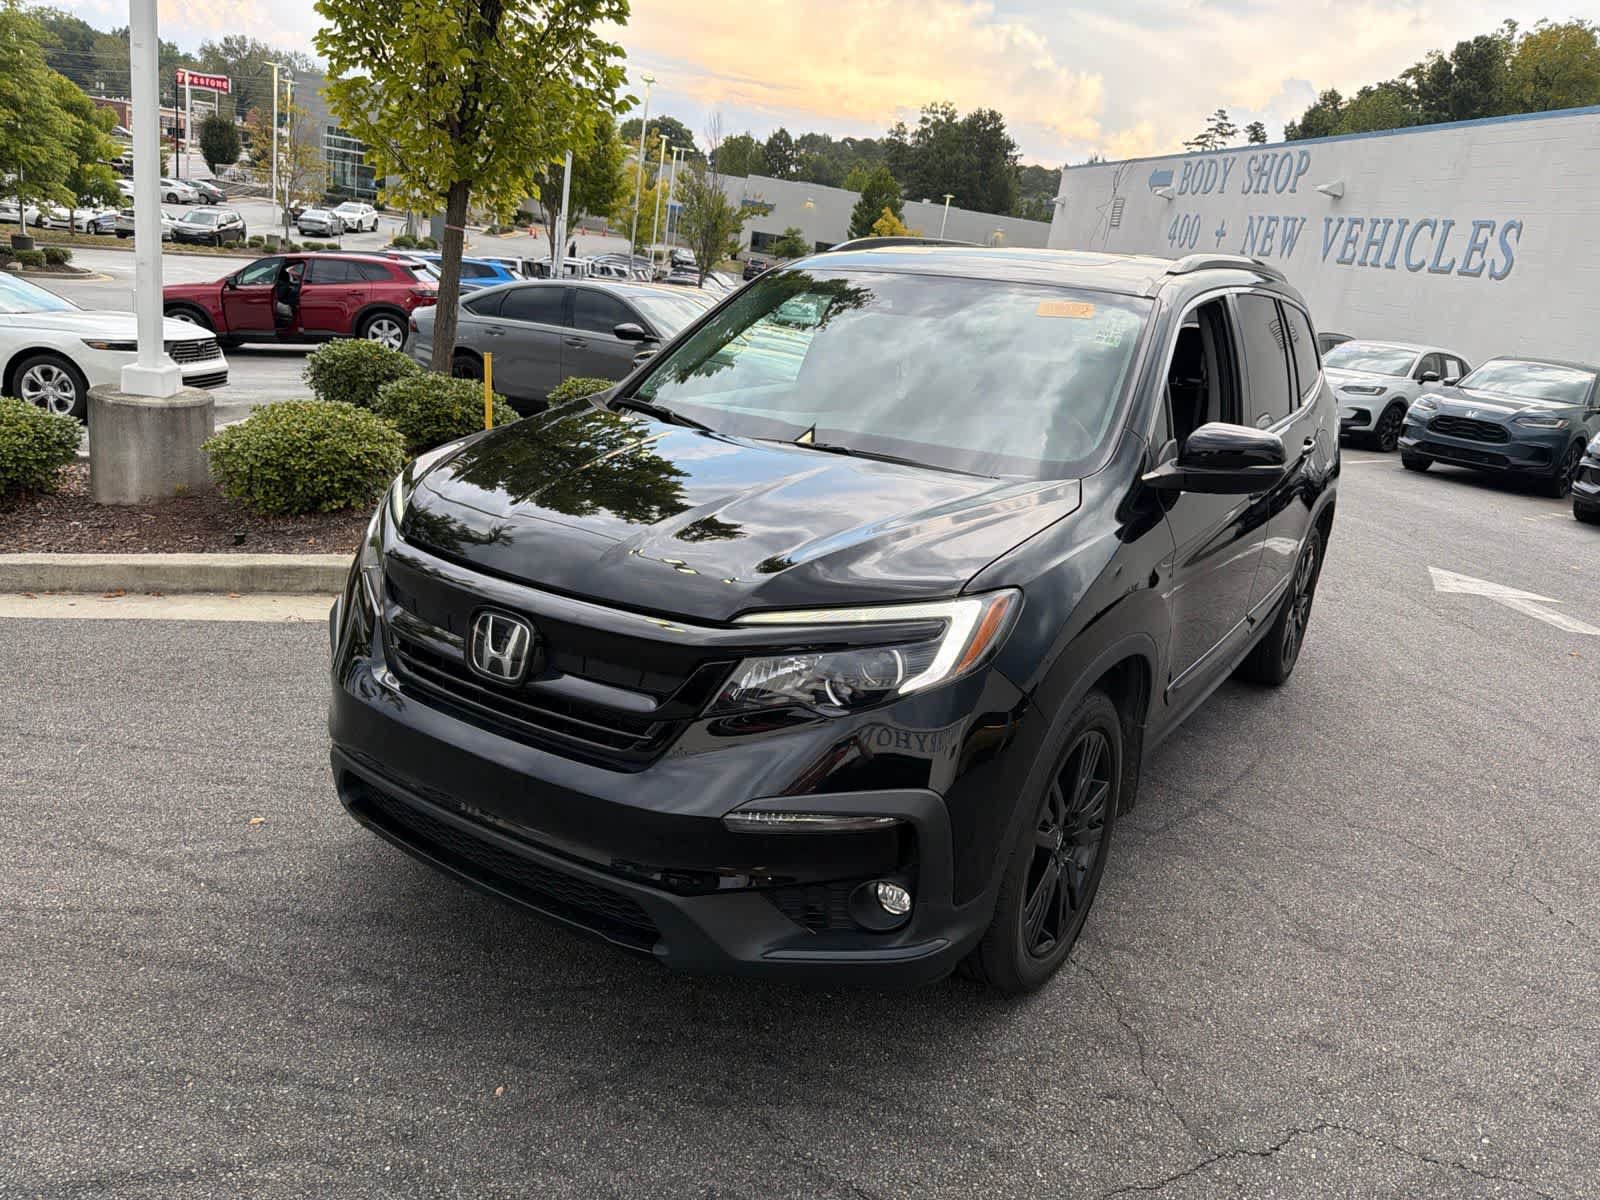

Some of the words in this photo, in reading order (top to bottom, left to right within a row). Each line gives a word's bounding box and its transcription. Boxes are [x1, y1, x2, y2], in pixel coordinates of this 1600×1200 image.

[176, 71, 228, 89] Frestone
[1177, 156, 1236, 195] BODY
[1241, 150, 1311, 195] SHOP
[1168, 213, 1200, 249] 400
[1240, 215, 1307, 259] NEW
[1322, 217, 1523, 280] VEHICLES
